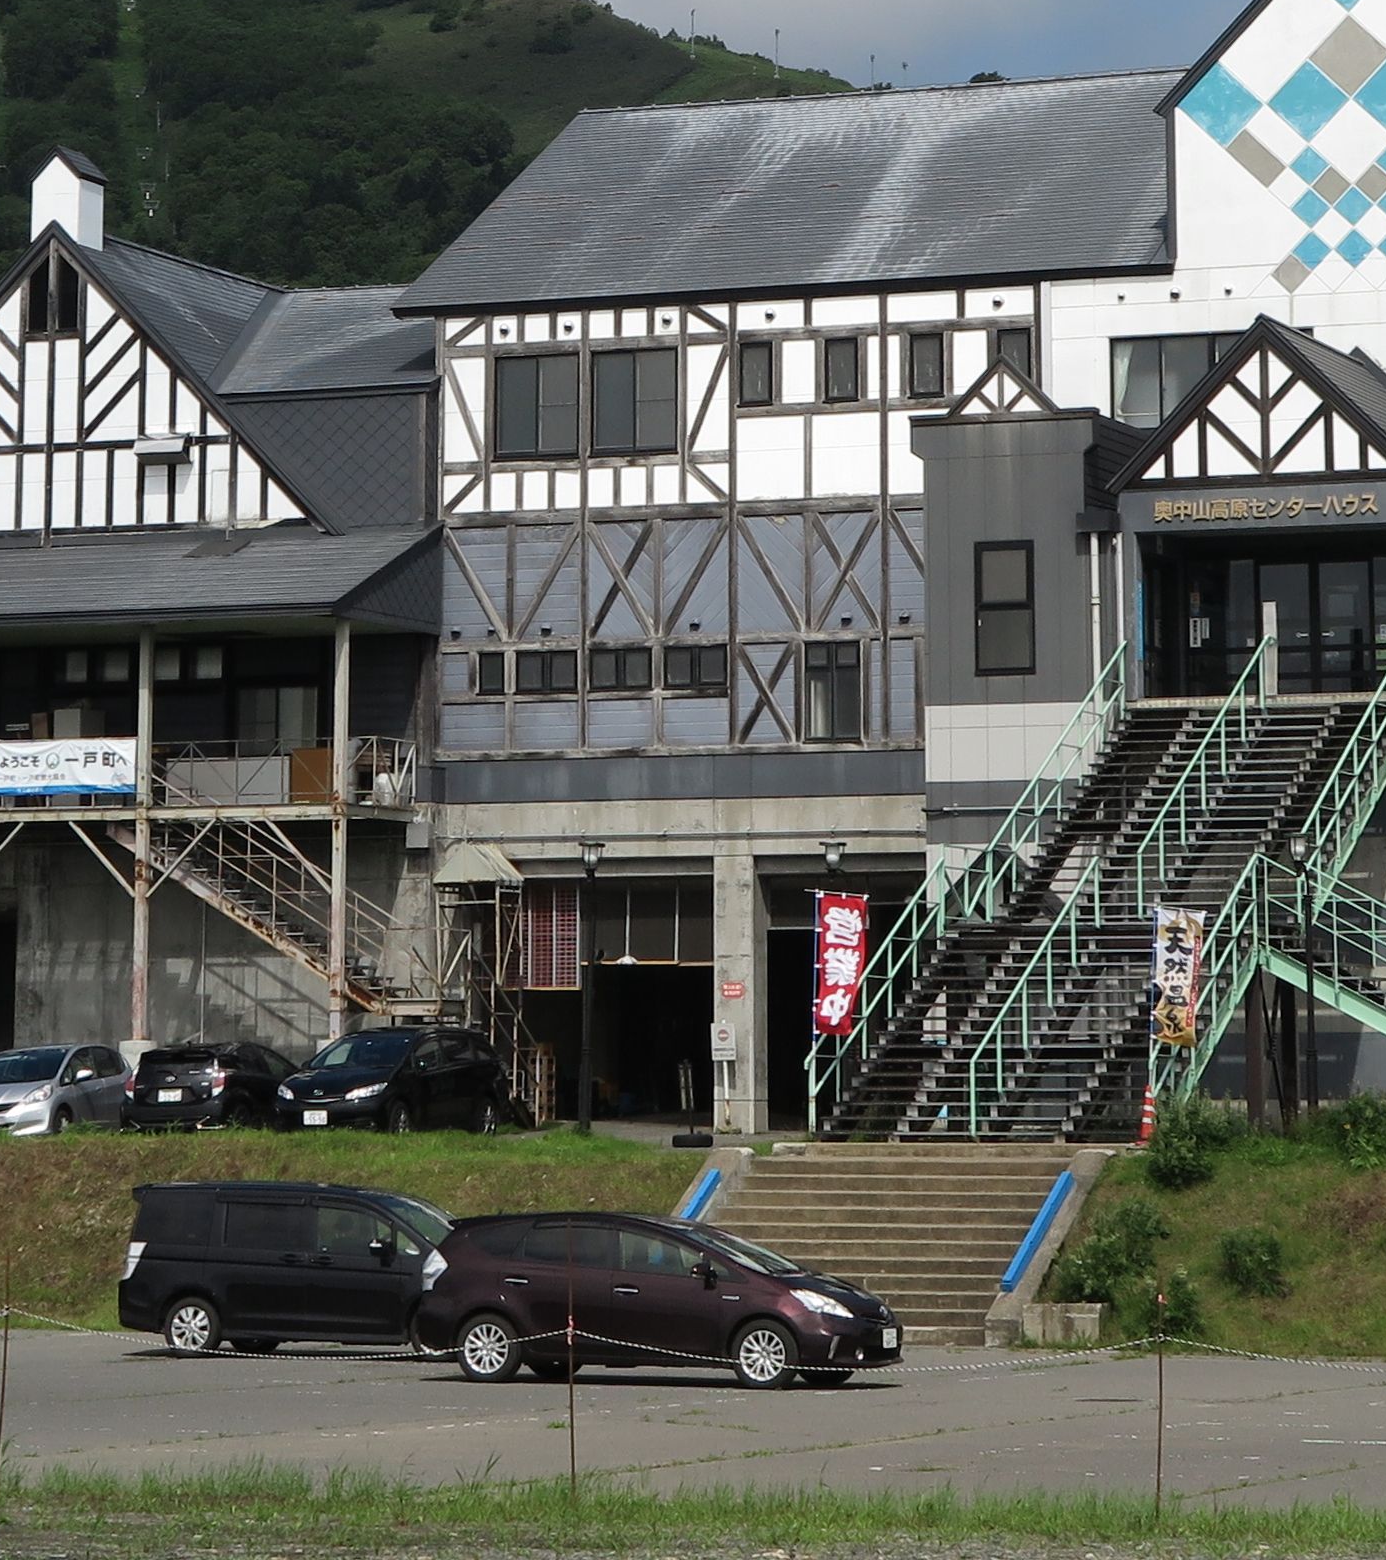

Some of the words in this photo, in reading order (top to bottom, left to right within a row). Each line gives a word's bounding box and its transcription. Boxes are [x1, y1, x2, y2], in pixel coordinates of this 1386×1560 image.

[1154, 494, 1379, 522] 奥中山高原センターハウス
[0, 755, 41, 768] ようこそ
[820, 906, 863, 1026] 営業中
[1164, 926, 1193, 1034] 天然温泉
